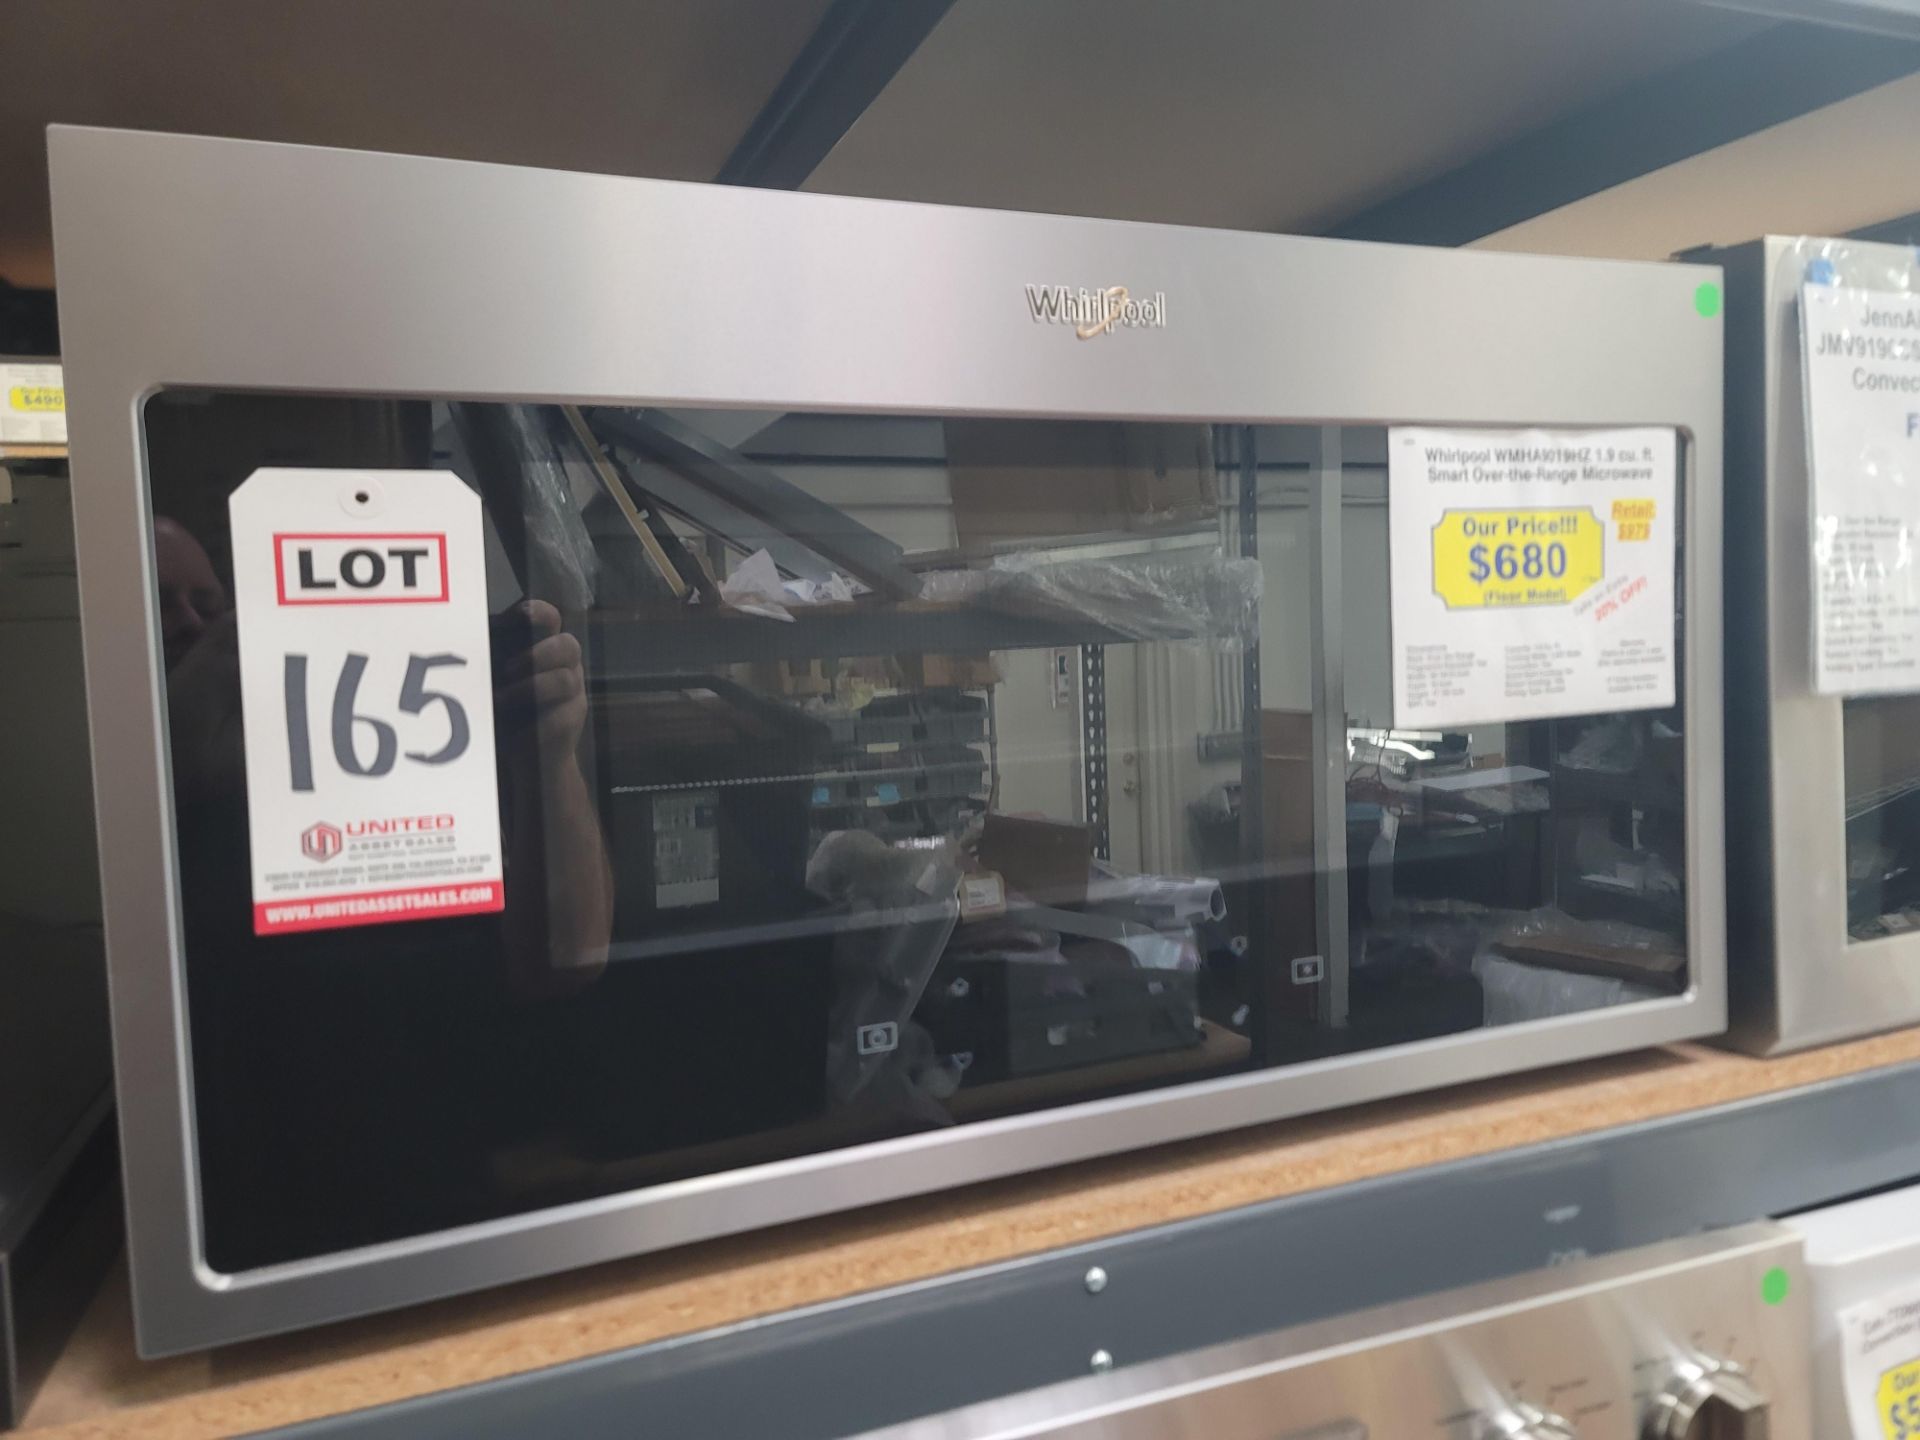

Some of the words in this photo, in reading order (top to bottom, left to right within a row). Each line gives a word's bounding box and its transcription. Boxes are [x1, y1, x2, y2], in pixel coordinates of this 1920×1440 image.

[1025, 284, 1166, 335] Whirlpool
[1425, 447, 1490, 466] Whirlpool
[1428, 466, 1468, 483] Smart
[1583, 466, 1654, 481] Microwave
[1463, 517, 1499, 537] Our
[1507, 515, 1578, 536] Price!!!
[297, 548, 429, 590] LOT
[1468, 542, 1567, 587] $680
[283, 651, 470, 793] 165
[346, 814, 454, 836] UNITED
[264, 886, 494, 924] WWW.UNITEDASSETSALES.COM
